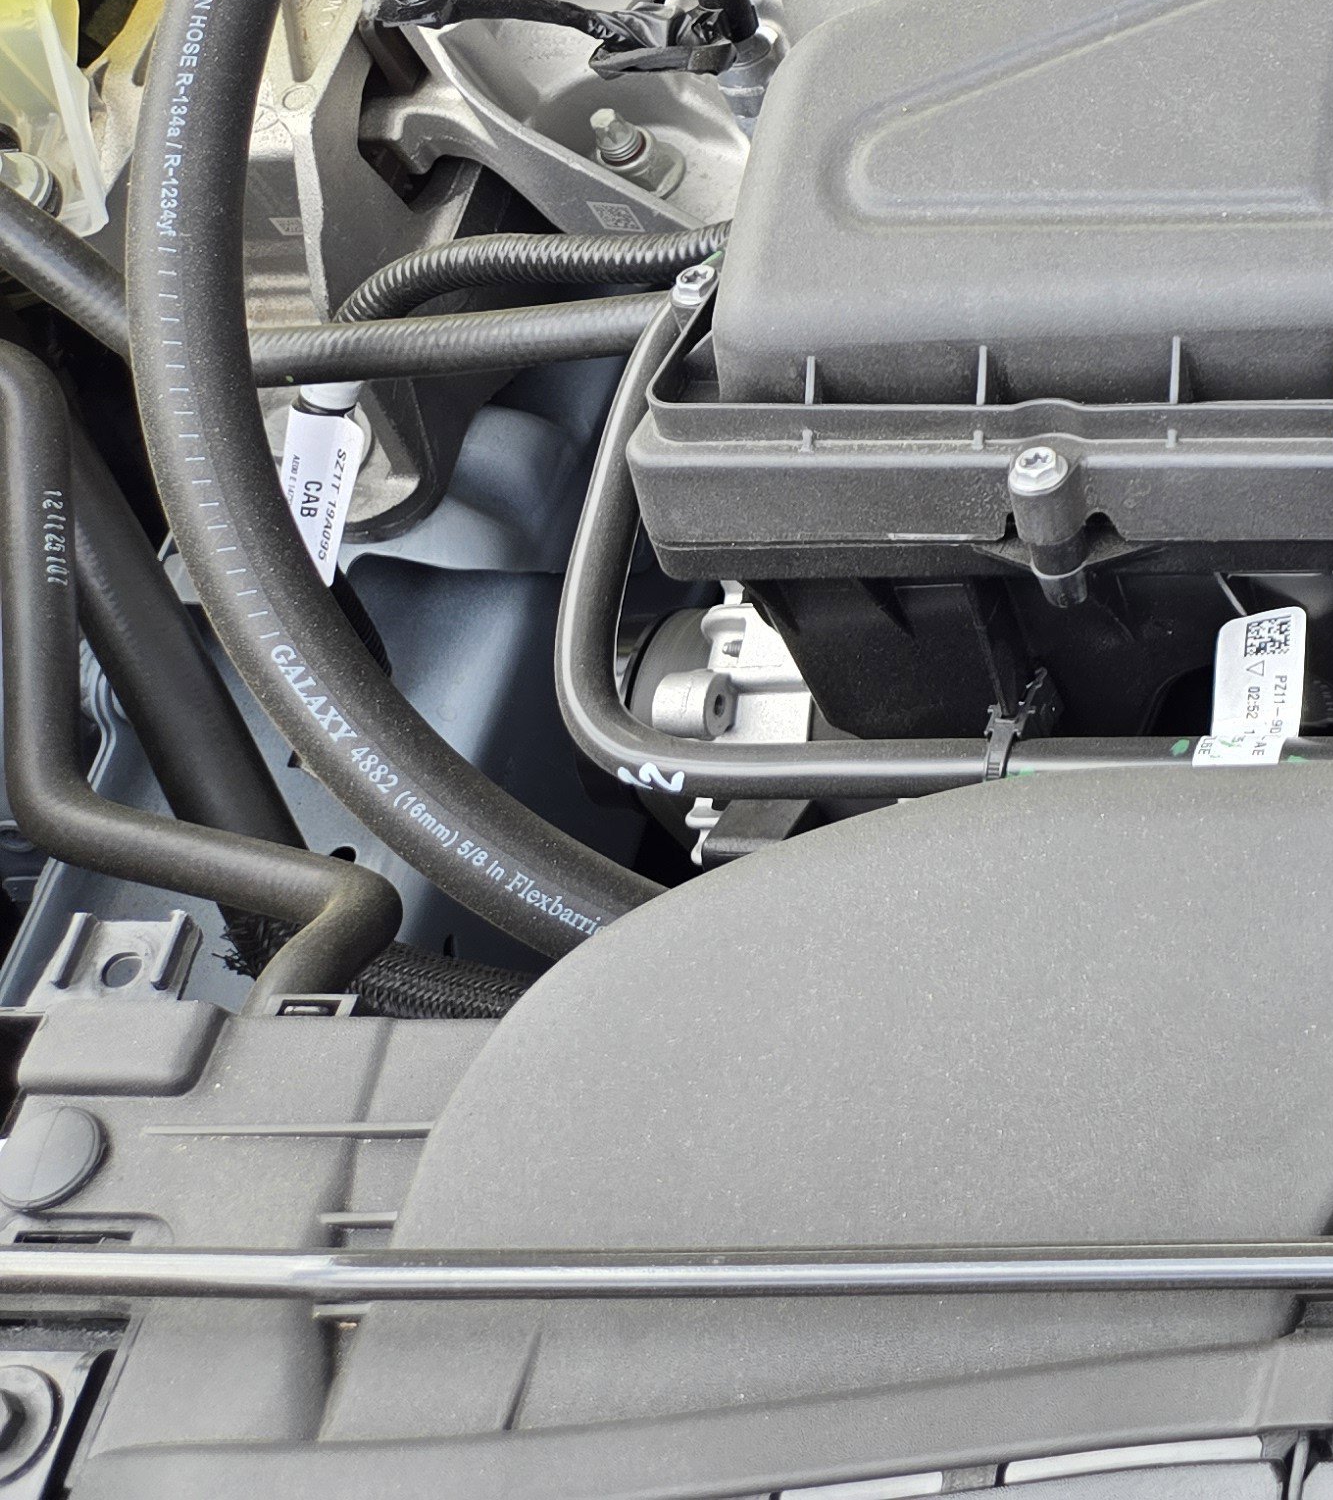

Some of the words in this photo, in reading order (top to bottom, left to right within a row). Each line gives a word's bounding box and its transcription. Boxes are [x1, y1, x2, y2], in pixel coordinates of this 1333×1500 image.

[180, 15, 208, 67] HOSE
[167, 73, 194, 138] R-134a
[157, 154, 182, 236] R-1234yf
[299, 477, 322, 522] CAB
[329, 447, 347, 495] SZ1T
[317, 496, 337, 564] 19A095
[1245, 686, 1260, 719] 02:52
[271, 644, 357, 743] GALAXY
[350, 745, 399, 794] 4882
[393, 790, 460, 848] (16mm)
[457, 840, 488, 867] 5/8
